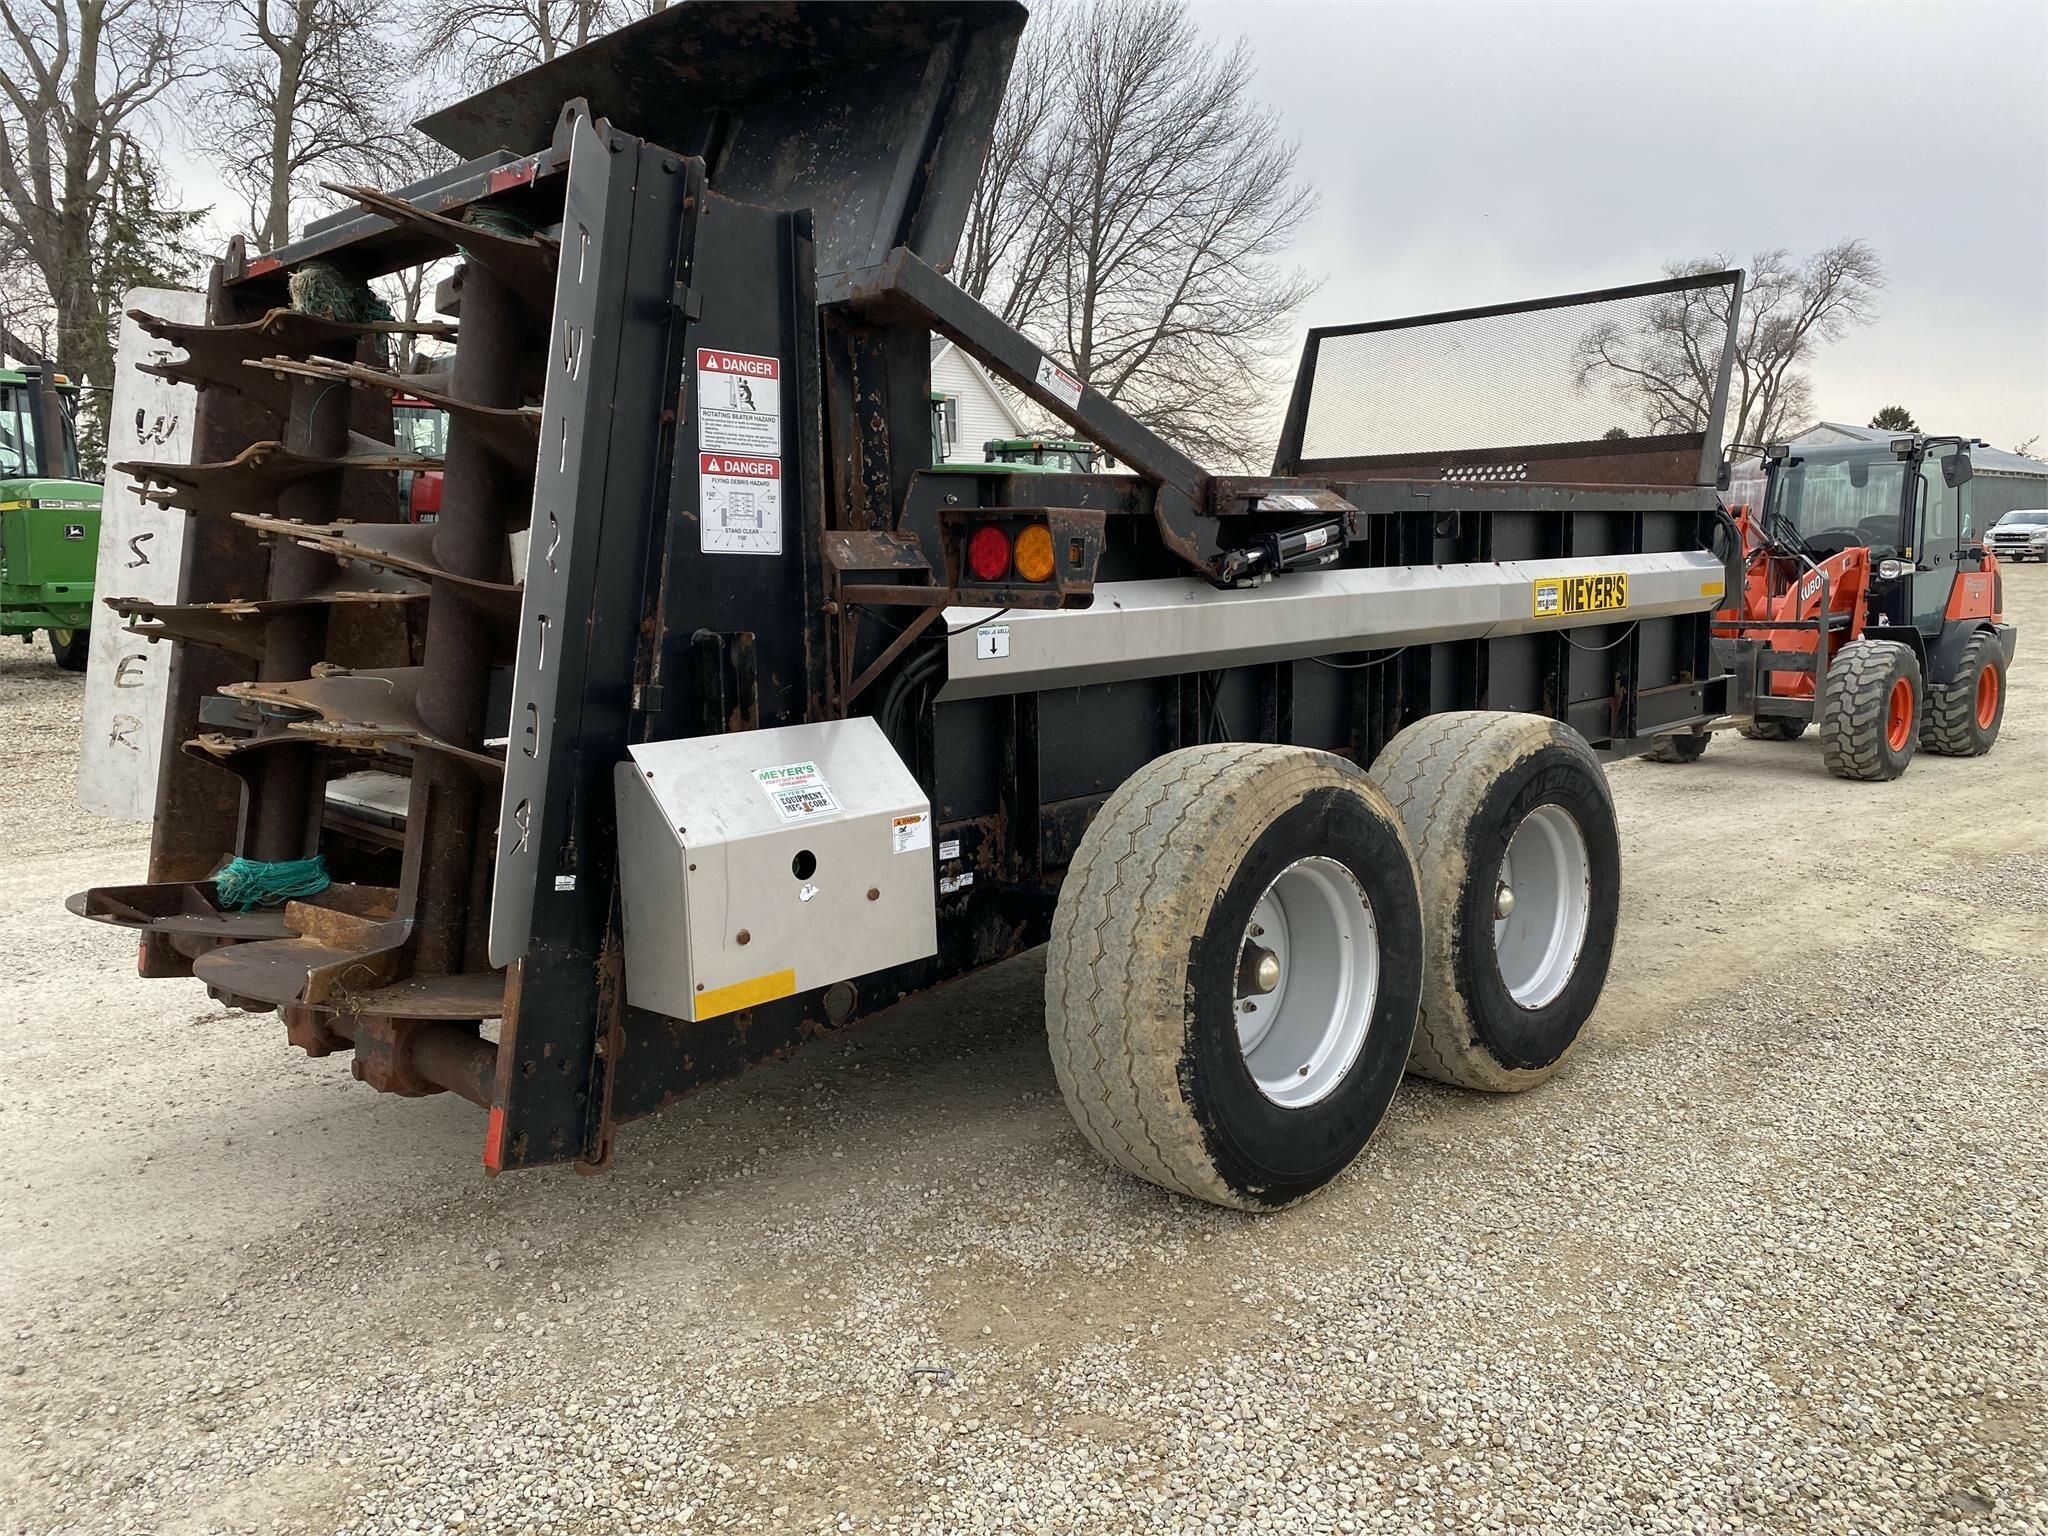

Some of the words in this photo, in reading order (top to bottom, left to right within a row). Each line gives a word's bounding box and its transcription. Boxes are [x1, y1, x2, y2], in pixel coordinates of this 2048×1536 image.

[722, 357, 773, 376] DANGER
[702, 410, 731, 419] ROTATING
[732, 413, 754, 421] BEATER
[754, 416, 776, 424] HAZARD
[724, 460, 774, 476] DANGER
[711, 477, 730, 485] FLYING
[1562, 575, 1625, 612] MEYER'S
[759, 764, 815, 781] MEYER'S
[780, 791, 824, 805] EQUIPMENT
[808, 799, 830, 808] CORP.
